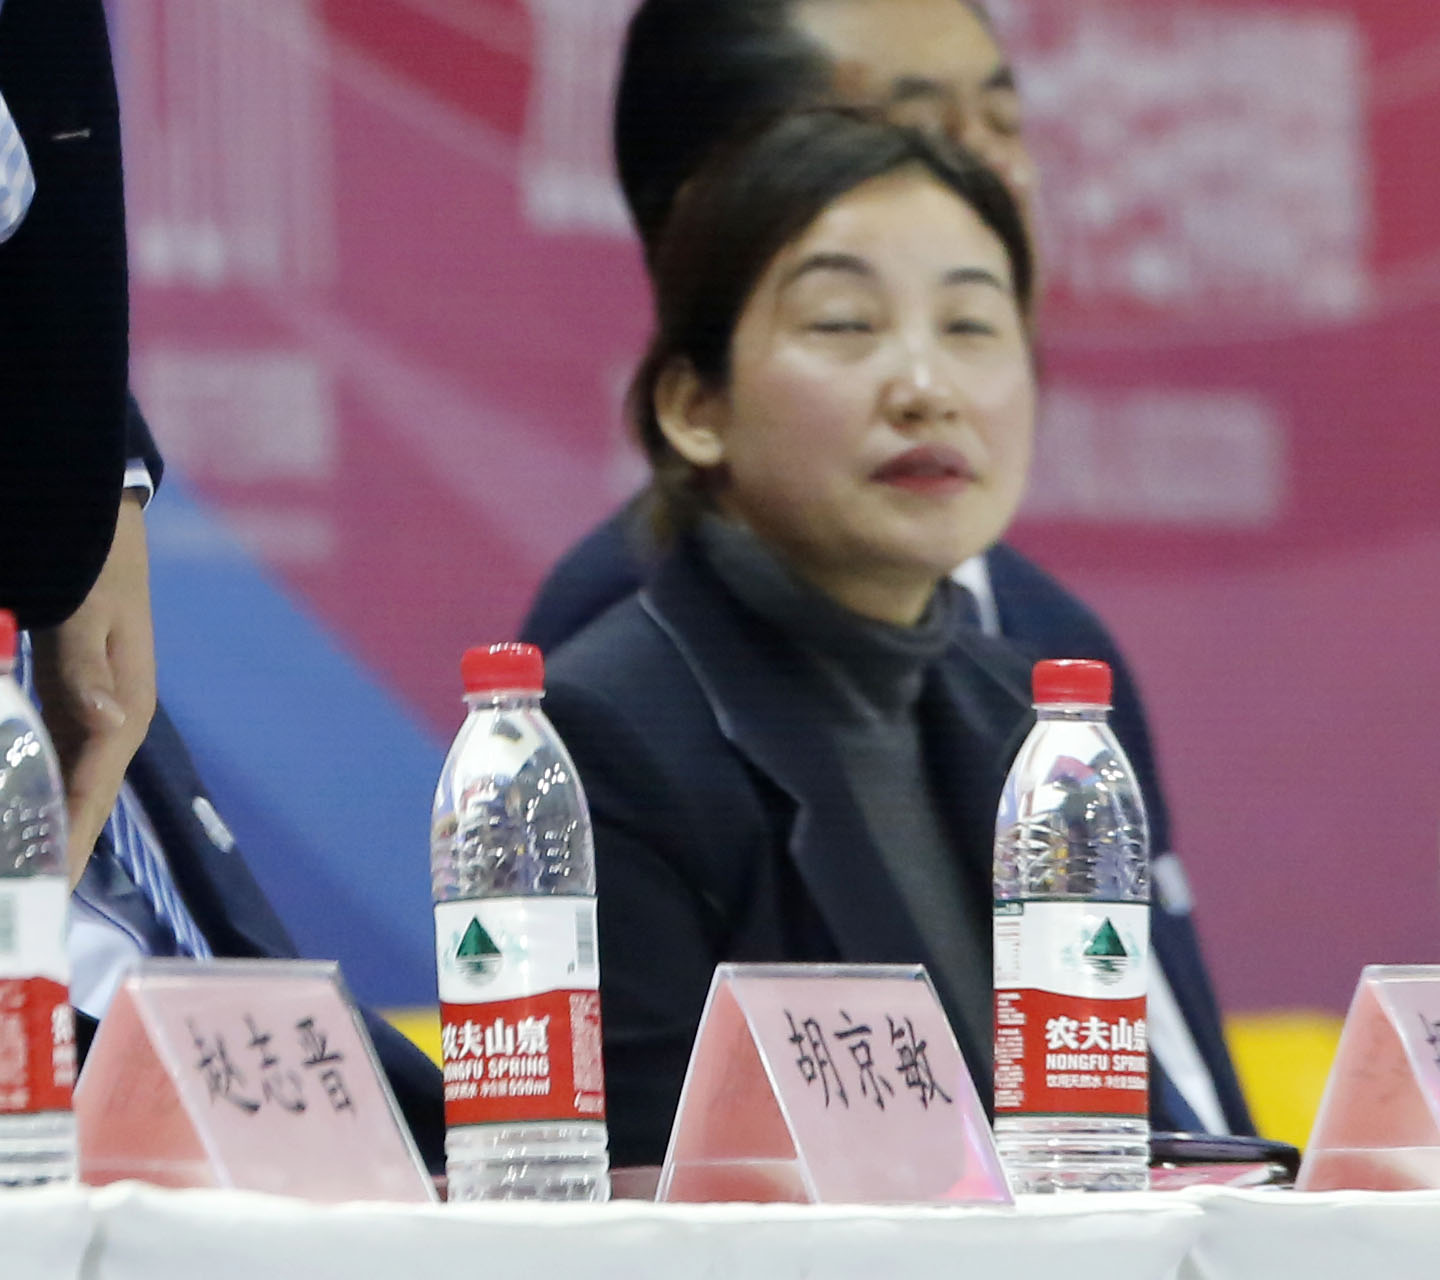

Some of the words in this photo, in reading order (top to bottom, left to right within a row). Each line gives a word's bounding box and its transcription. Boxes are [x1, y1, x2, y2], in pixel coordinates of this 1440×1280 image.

[783, 1008, 954, 1112] 胡京敏
[1045, 1052, 1109, 1072] NONGFU
